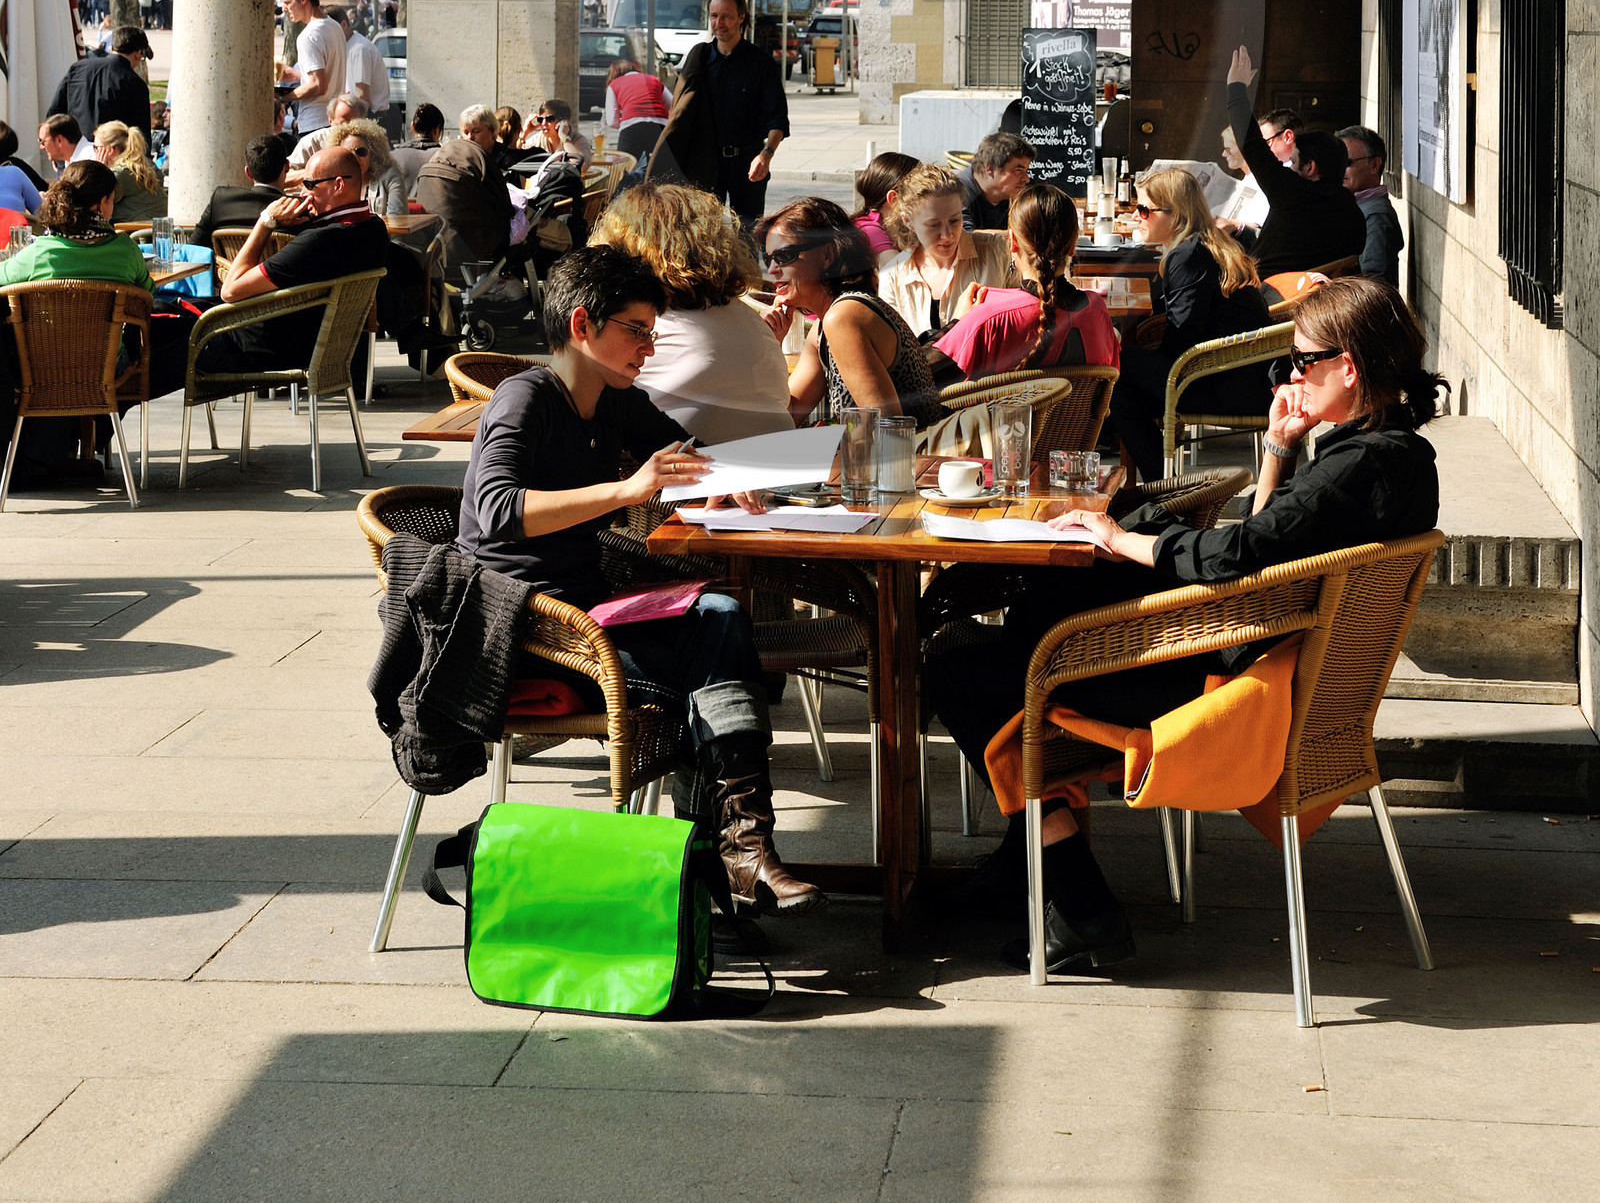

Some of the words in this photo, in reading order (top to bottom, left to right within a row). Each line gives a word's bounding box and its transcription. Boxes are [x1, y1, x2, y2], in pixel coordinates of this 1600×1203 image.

[1073, 5, 1103, 17] Thomas
[1104, 5, 1131, 18] Jäger
[1042, 39, 1076, 55] rivella
[1043, 102, 1049, 111] in
